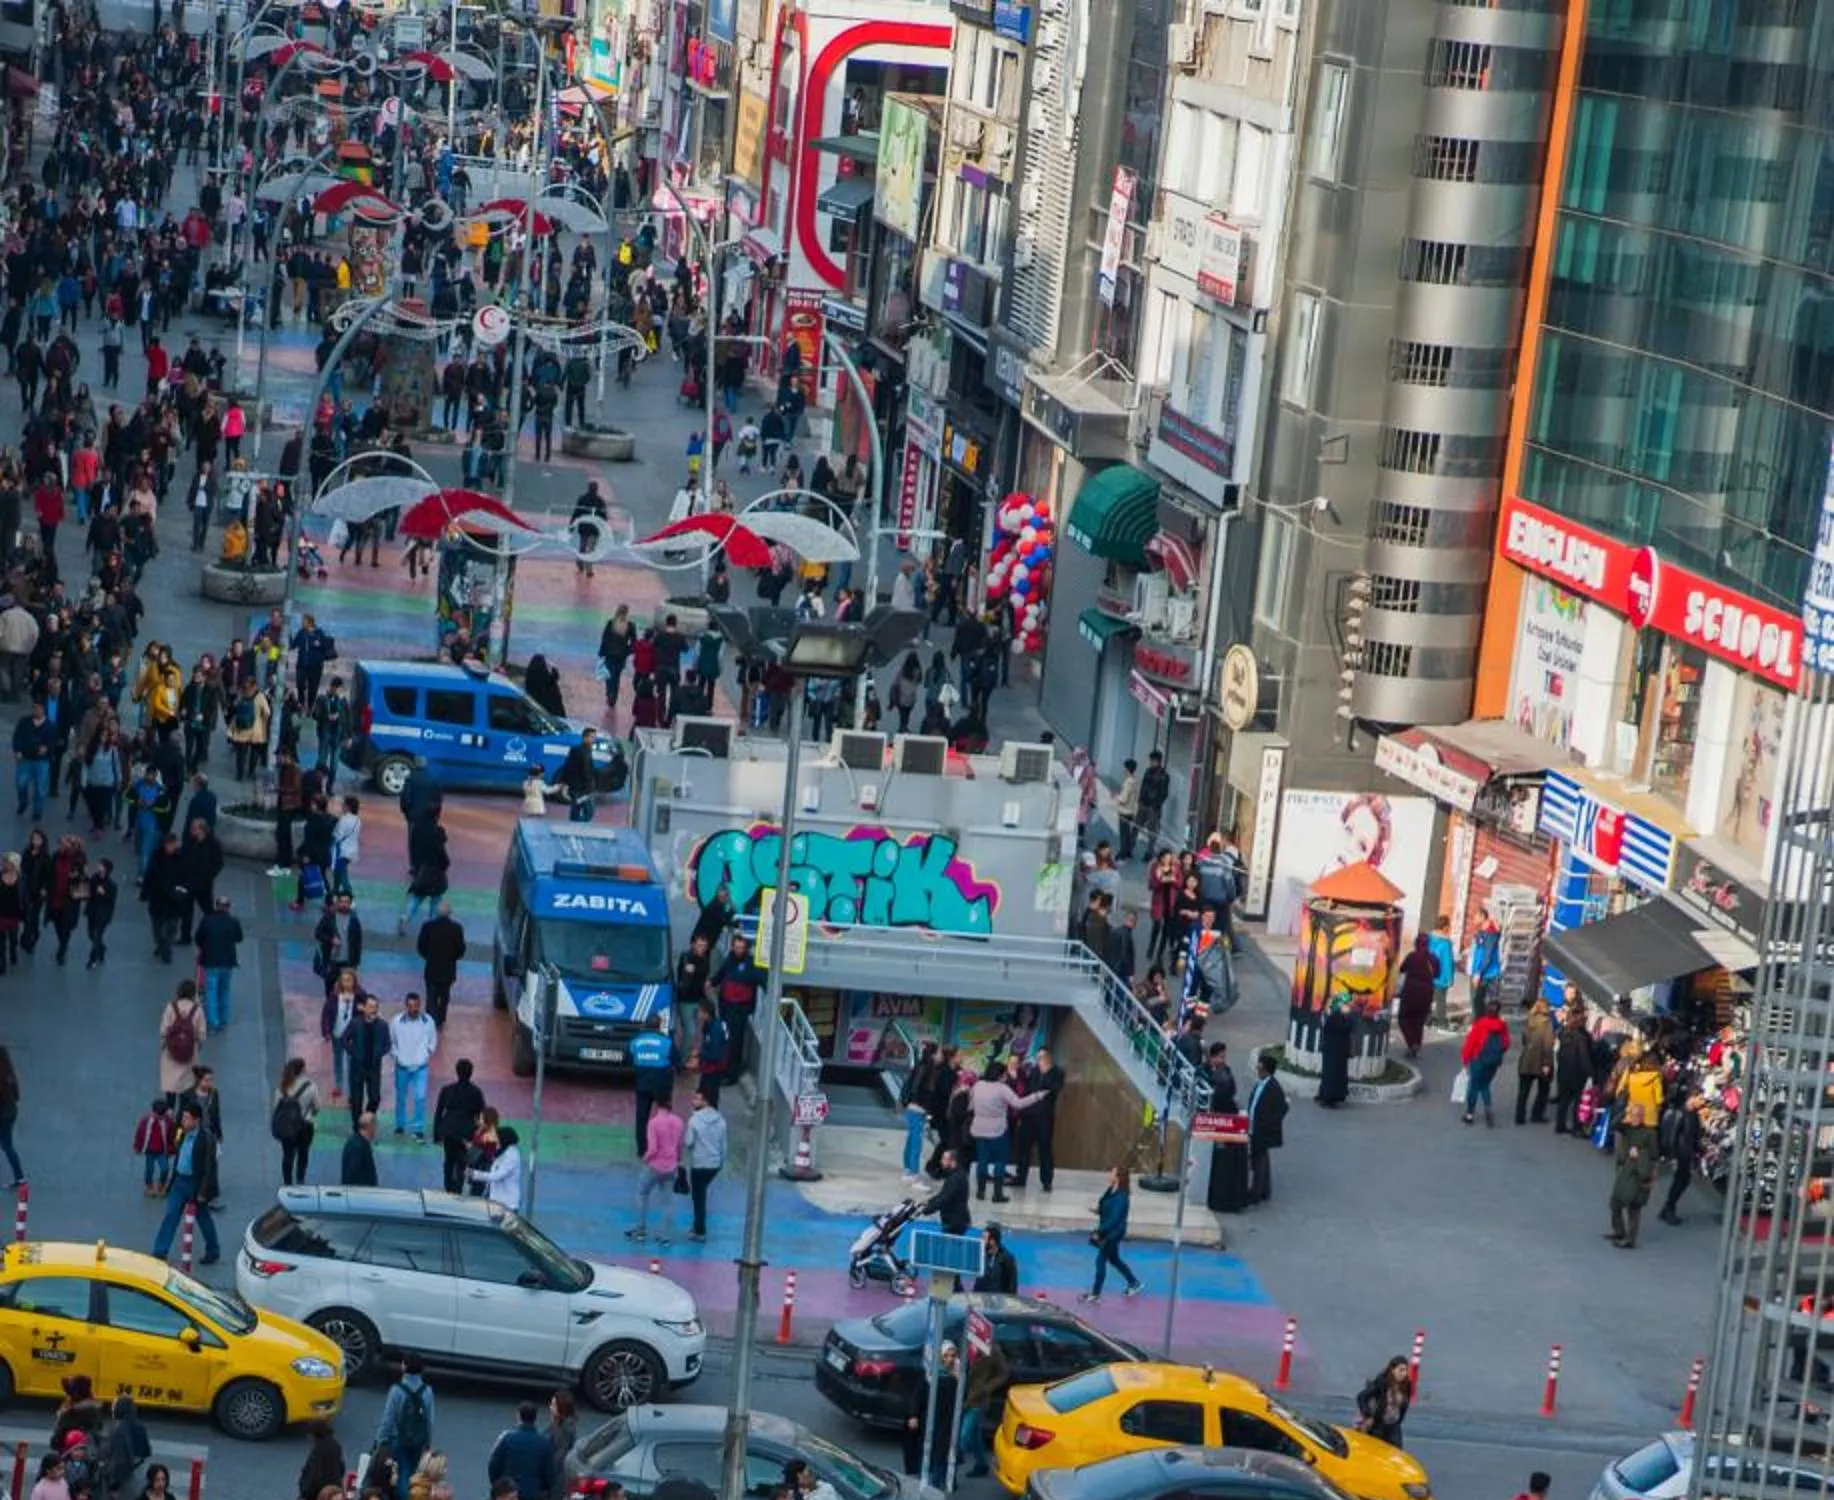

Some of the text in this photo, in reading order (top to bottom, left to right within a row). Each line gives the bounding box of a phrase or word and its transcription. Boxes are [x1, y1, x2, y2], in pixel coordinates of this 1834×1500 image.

[1506, 511, 1606, 590] ENGLISH
[1685, 591, 1793, 678] SCHOOL
[552, 893, 649, 917] ZABITA
[876, 998, 920, 1017] AVM
